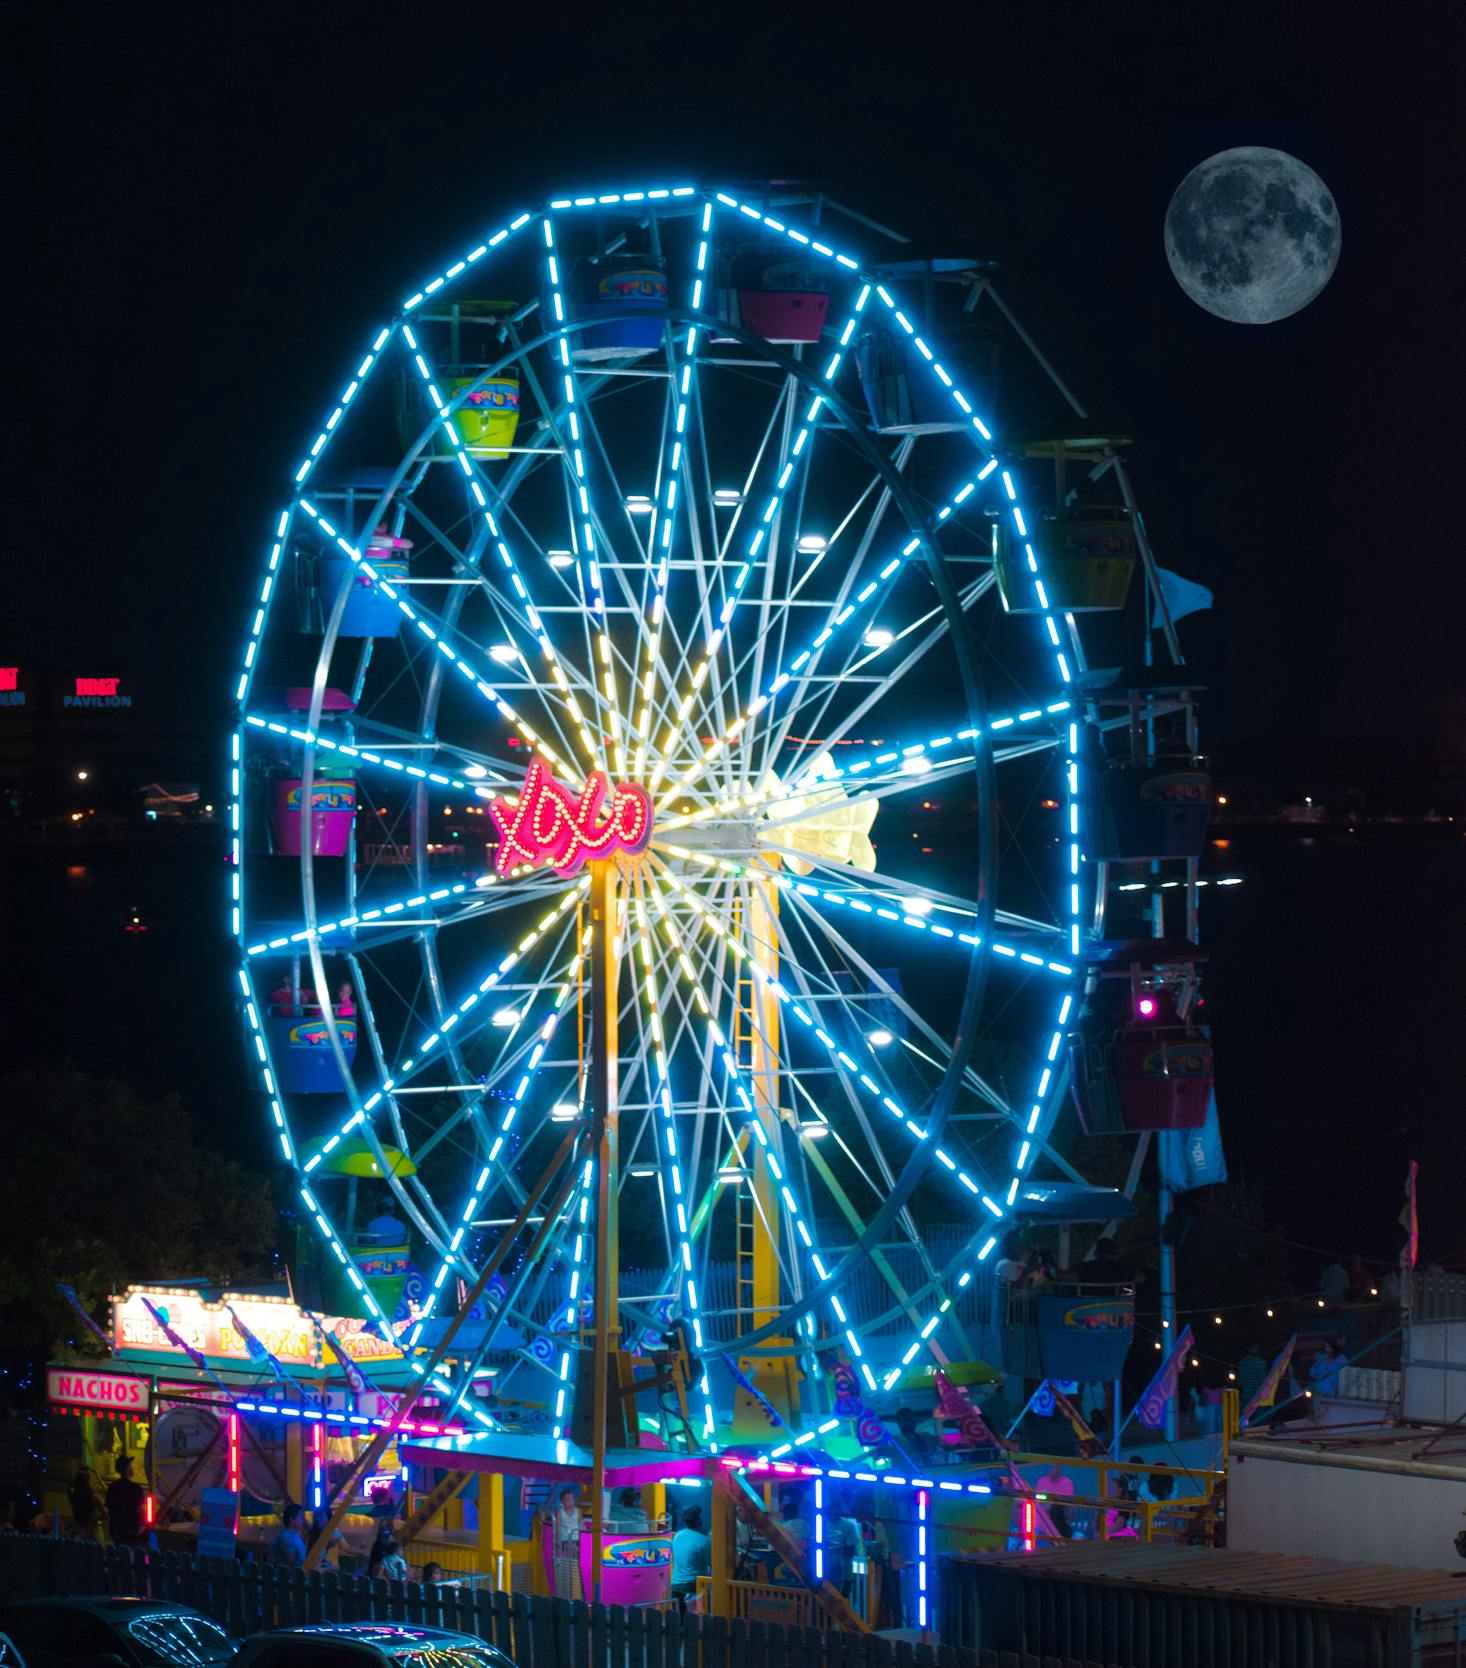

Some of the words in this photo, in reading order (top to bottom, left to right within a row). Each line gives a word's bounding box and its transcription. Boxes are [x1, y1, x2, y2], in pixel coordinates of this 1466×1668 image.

[63, 695, 132, 707] PAVILION
[219, 1327, 307, 1358] POCORN
[342, 1336, 402, 1357] CAND
[58, 1376, 140, 1404] NACHOS
